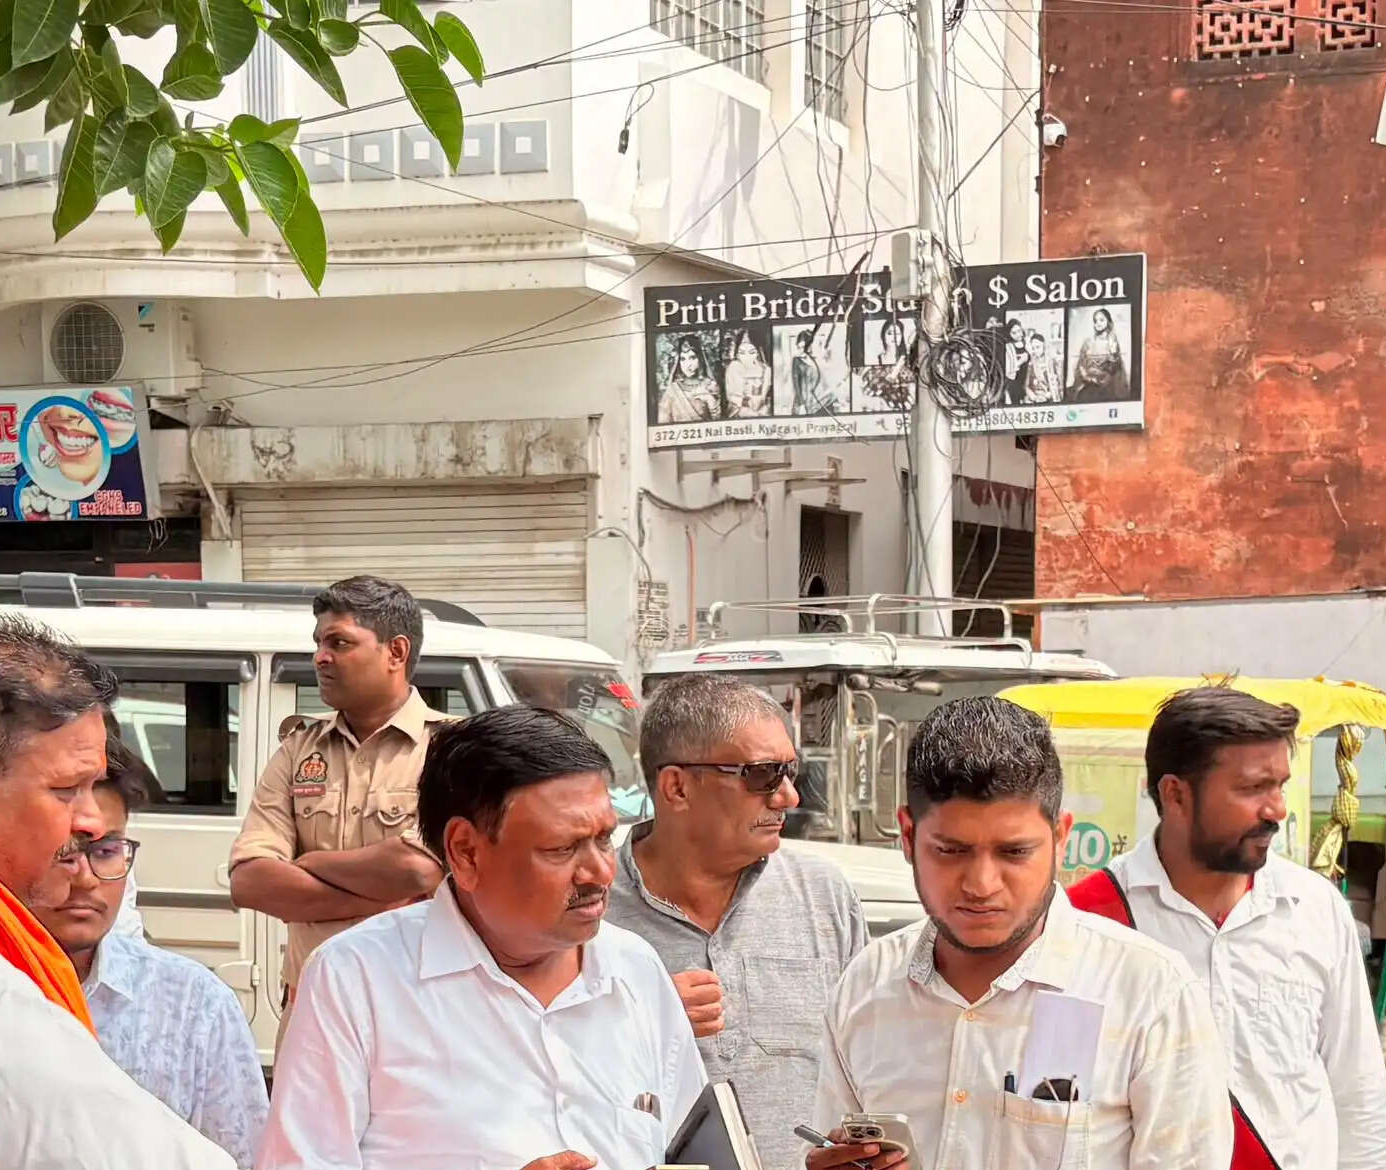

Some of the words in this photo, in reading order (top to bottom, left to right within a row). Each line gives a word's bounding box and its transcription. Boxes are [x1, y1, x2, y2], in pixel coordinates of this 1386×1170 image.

[656, 294, 728, 327] Priti
[1025, 271, 1126, 304] Salon
[654, 428, 702, 442] 372/321
[705, 426, 723, 438] Nai
